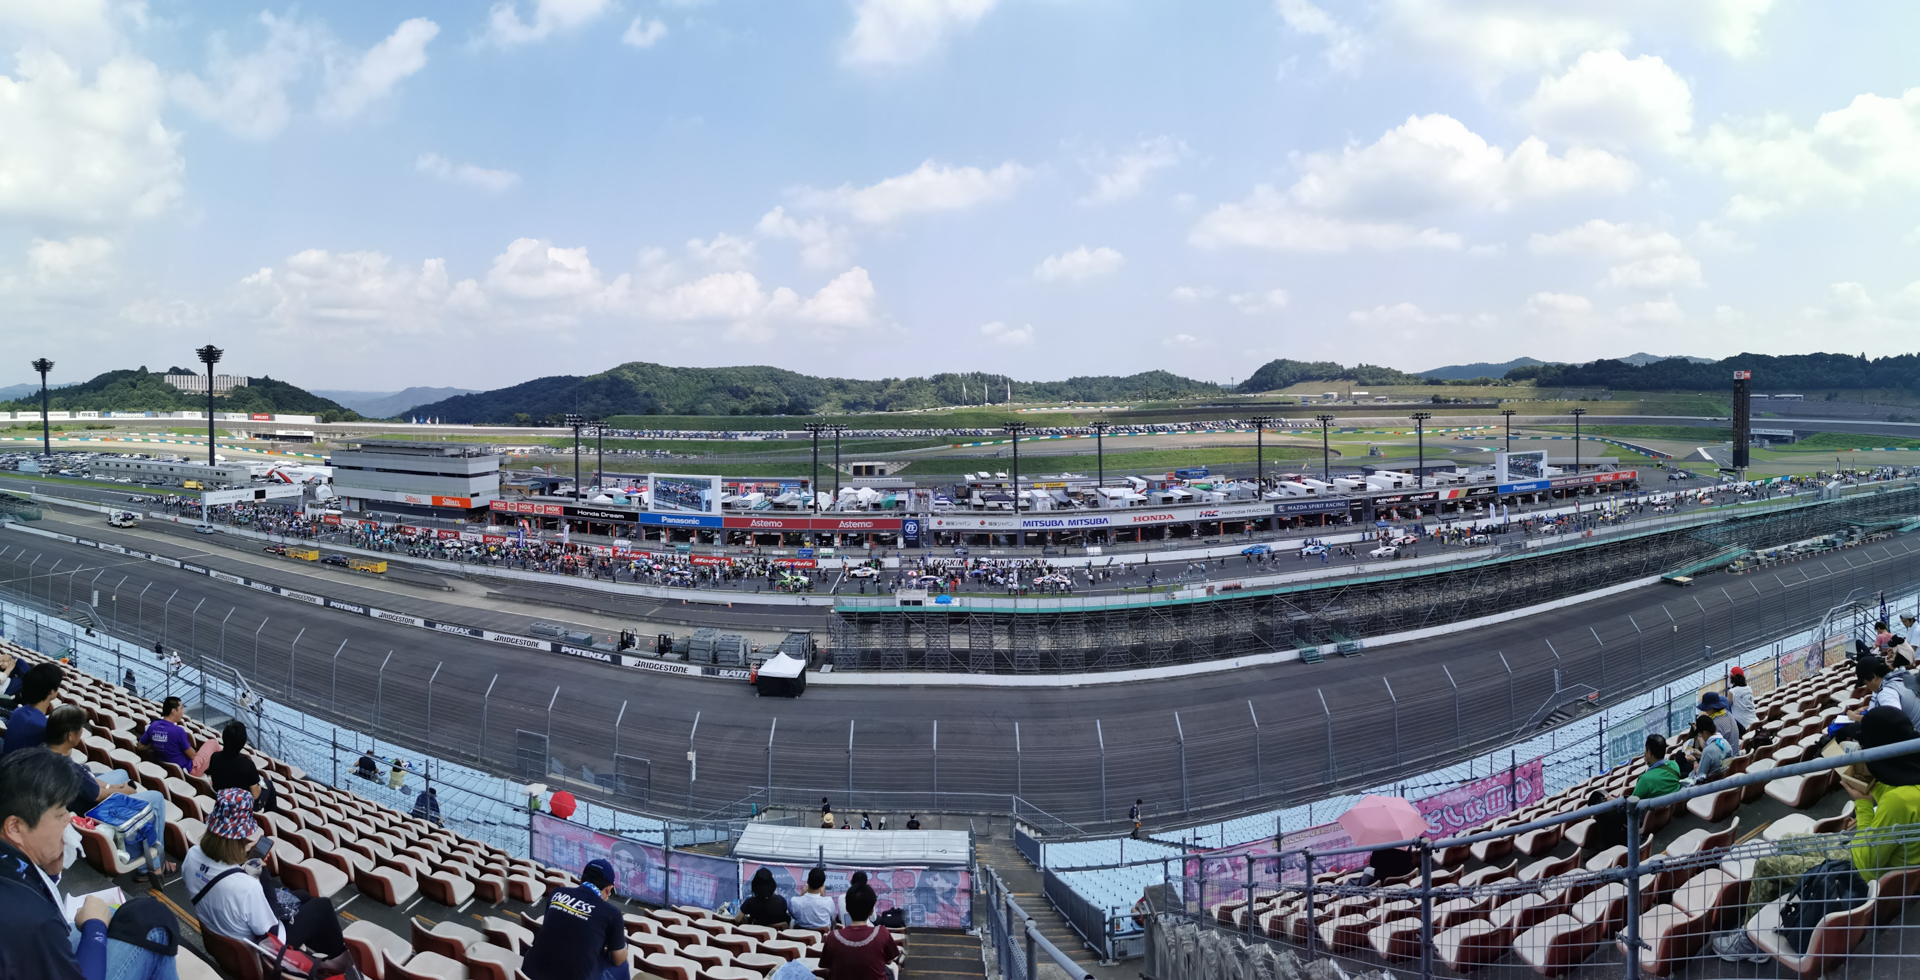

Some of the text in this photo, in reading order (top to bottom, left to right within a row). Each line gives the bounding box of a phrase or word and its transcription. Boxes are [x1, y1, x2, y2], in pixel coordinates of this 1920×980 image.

[662, 516, 700, 525] Panasonic
[750, 519, 782, 527] Astemo
[184, 564, 206, 574] POTENZA
[288, 591, 317, 602] BRIDGESTONE
[330, 601, 364, 613] POTENZA
[379, 611, 415, 624] BRIDGESTONE
[494, 634, 540, 648] BRIDGESTONE
[561, 646, 612, 662] POTENZA
[634, 660, 688, 673] BRIDGESTONE
[551, 892, 596, 913] ENDLESS
